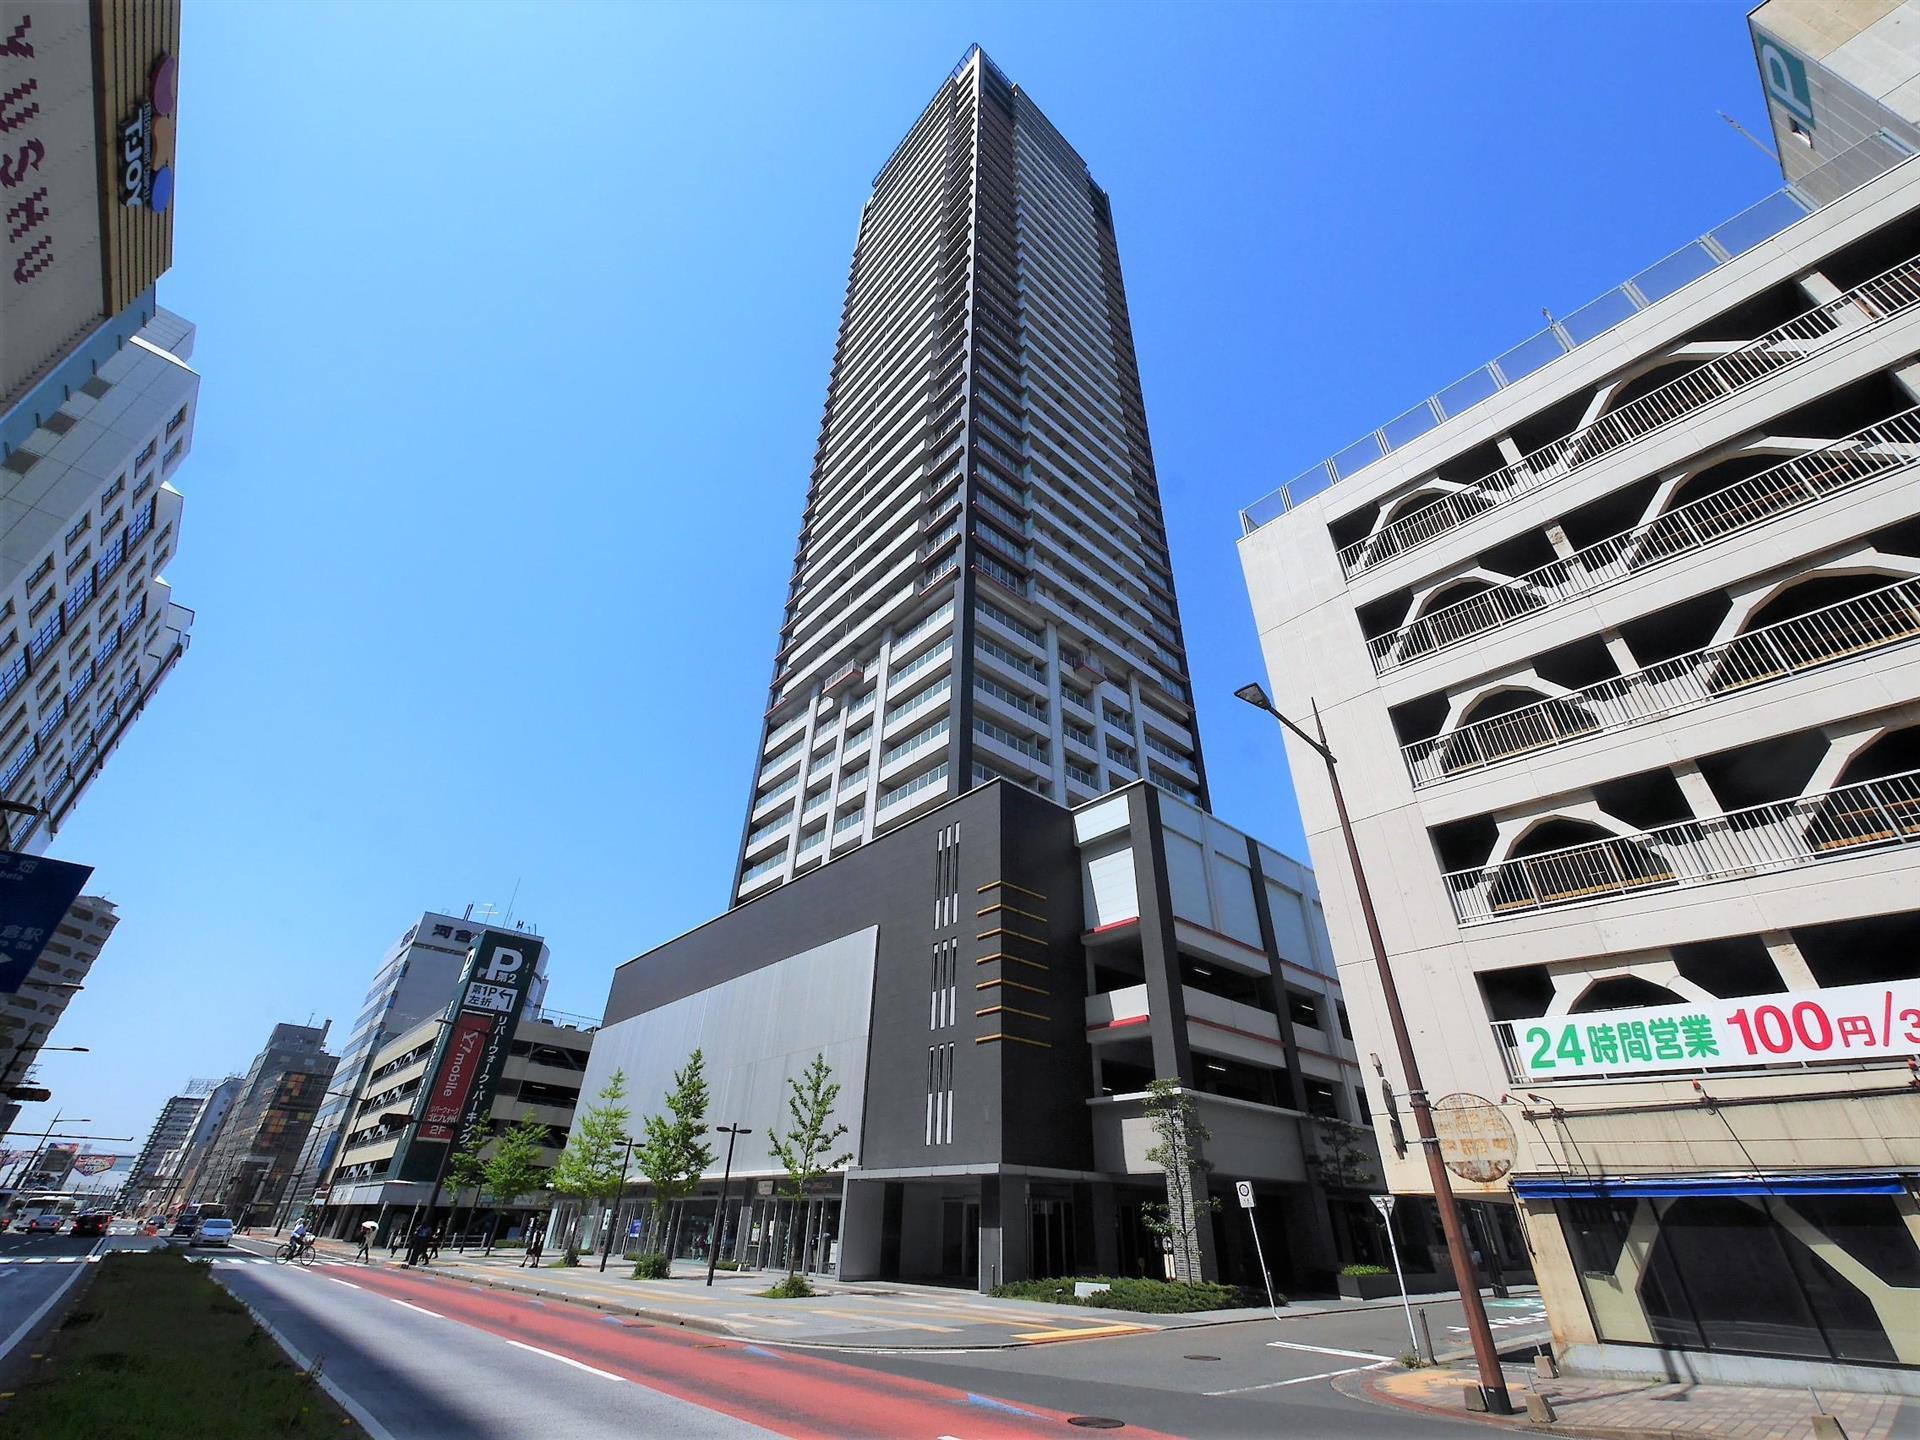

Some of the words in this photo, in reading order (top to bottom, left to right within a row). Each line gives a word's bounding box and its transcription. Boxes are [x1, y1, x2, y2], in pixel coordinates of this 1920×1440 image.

[1762, 44, 1812, 118] P
[485, 946, 523, 980] P
[1526, 1013, 1720, 1069] 24時間営業
[429, 1125, 446, 1135] 2F
